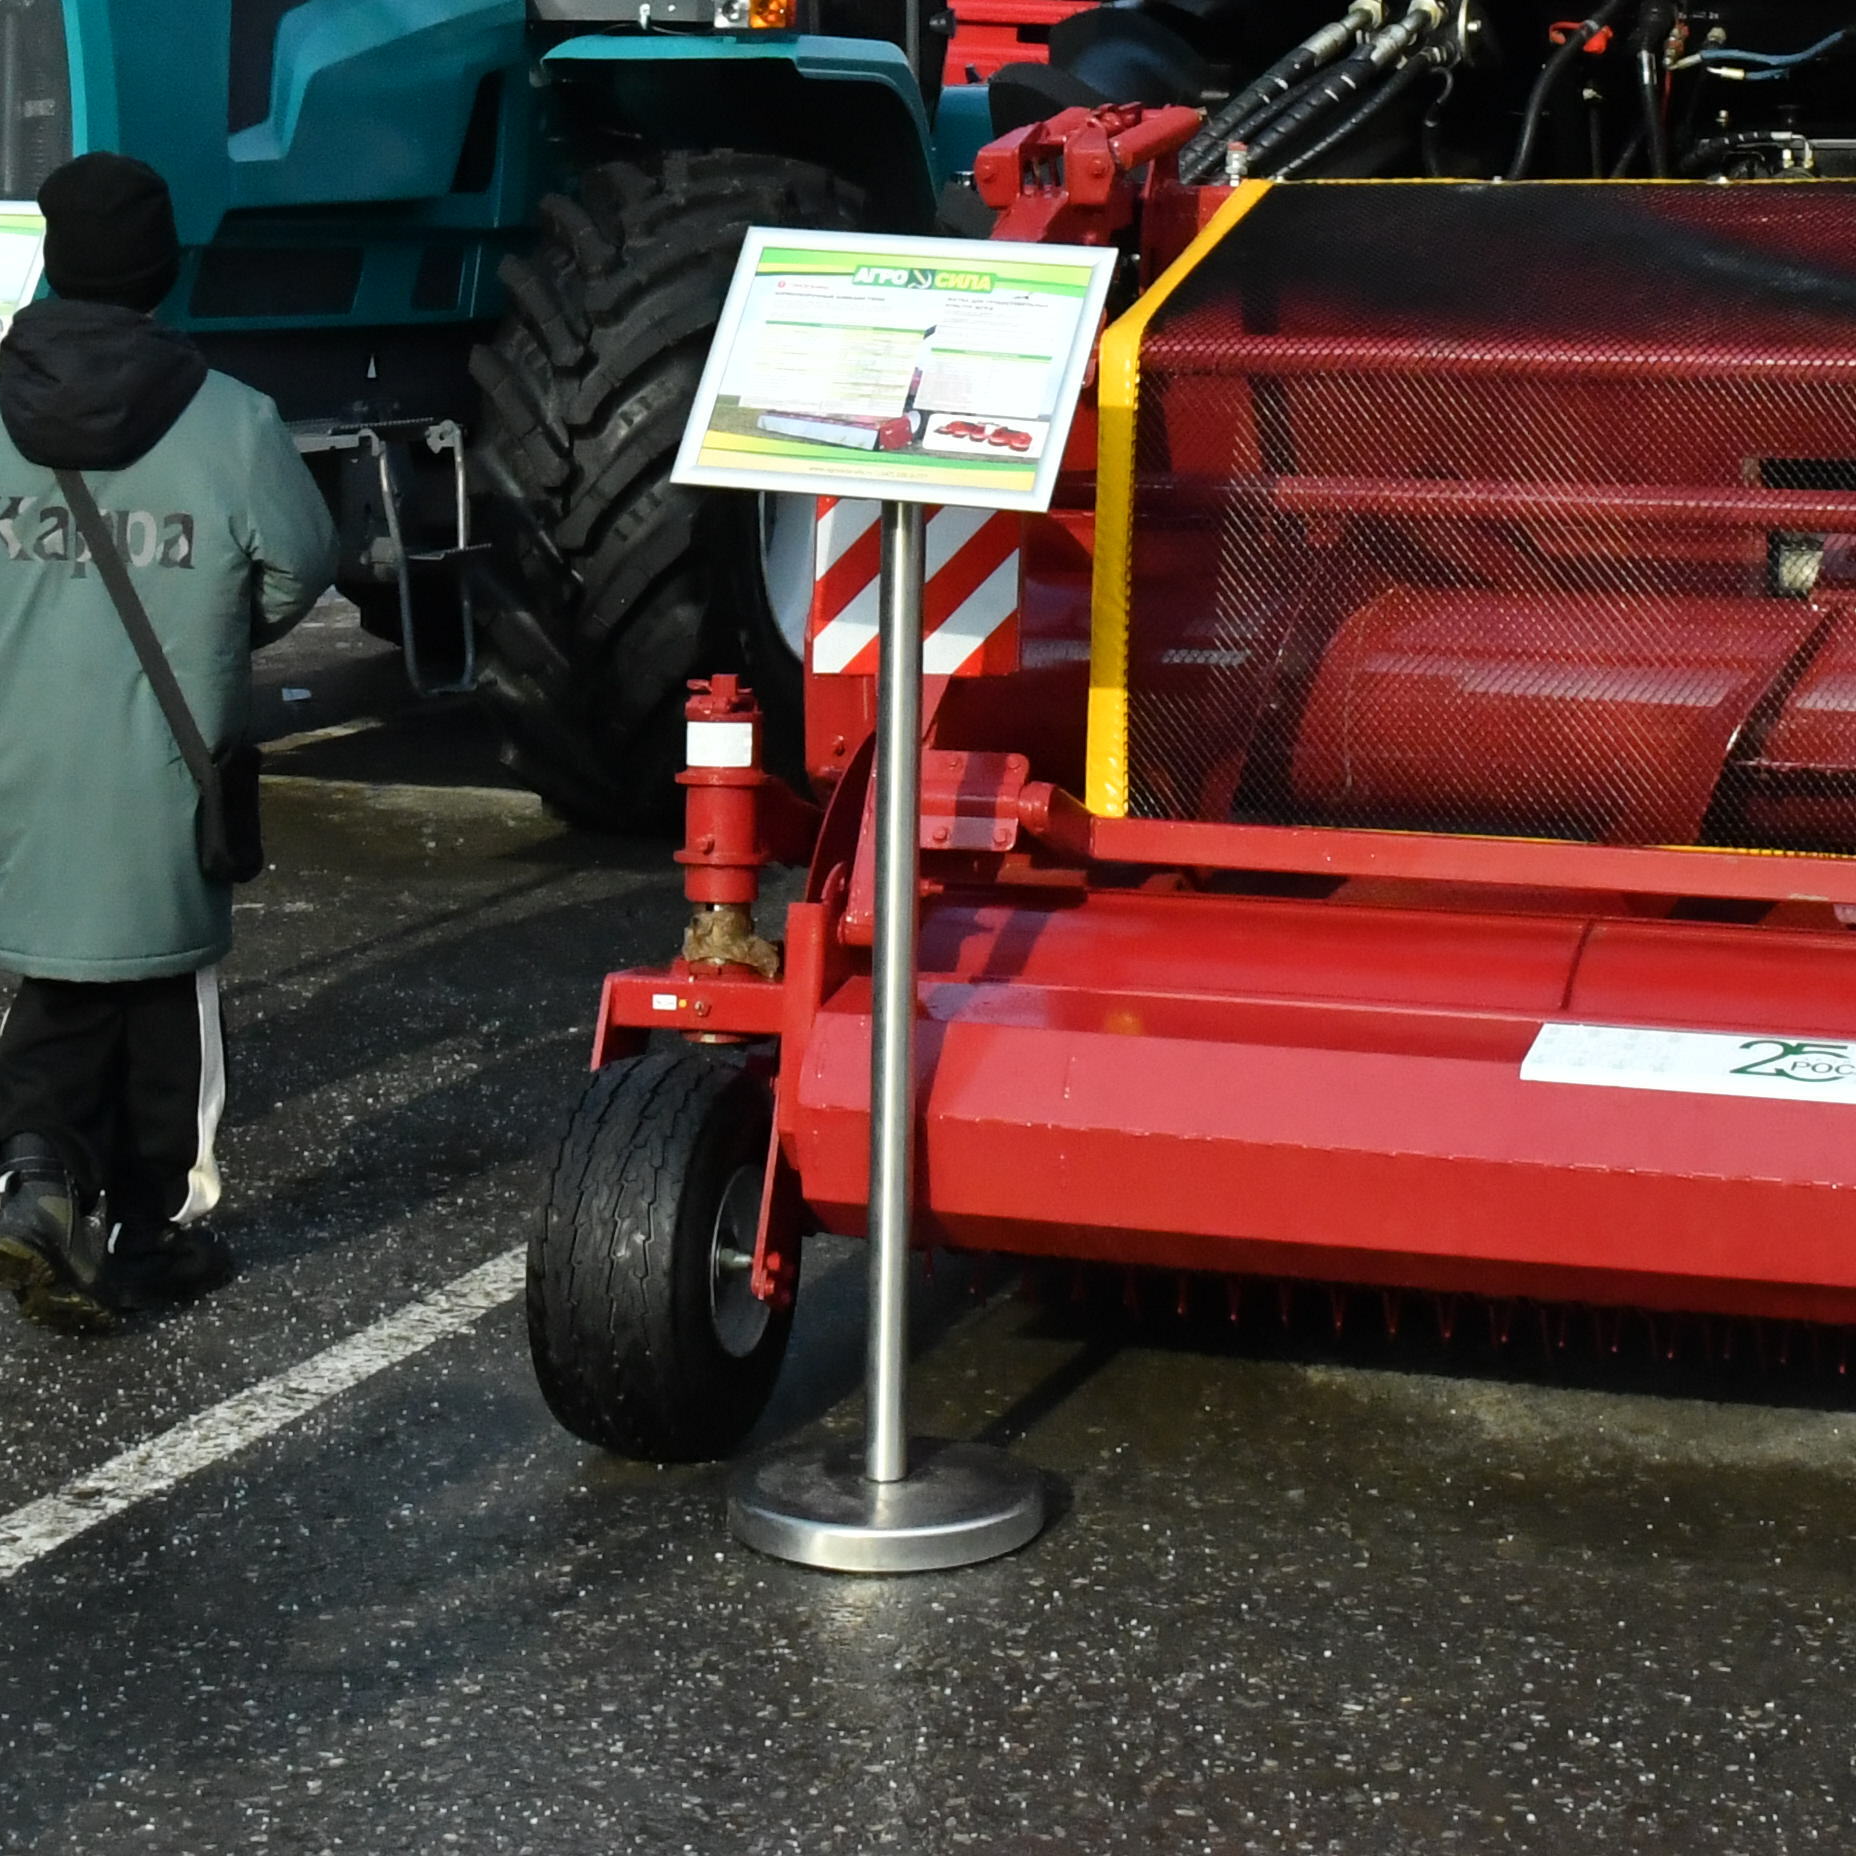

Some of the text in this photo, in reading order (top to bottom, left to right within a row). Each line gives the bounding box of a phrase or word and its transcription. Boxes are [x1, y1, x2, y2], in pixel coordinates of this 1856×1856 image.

[852, 267, 992, 292] АГРО СИЛА
[1728, 1039, 1850, 1083] 25
